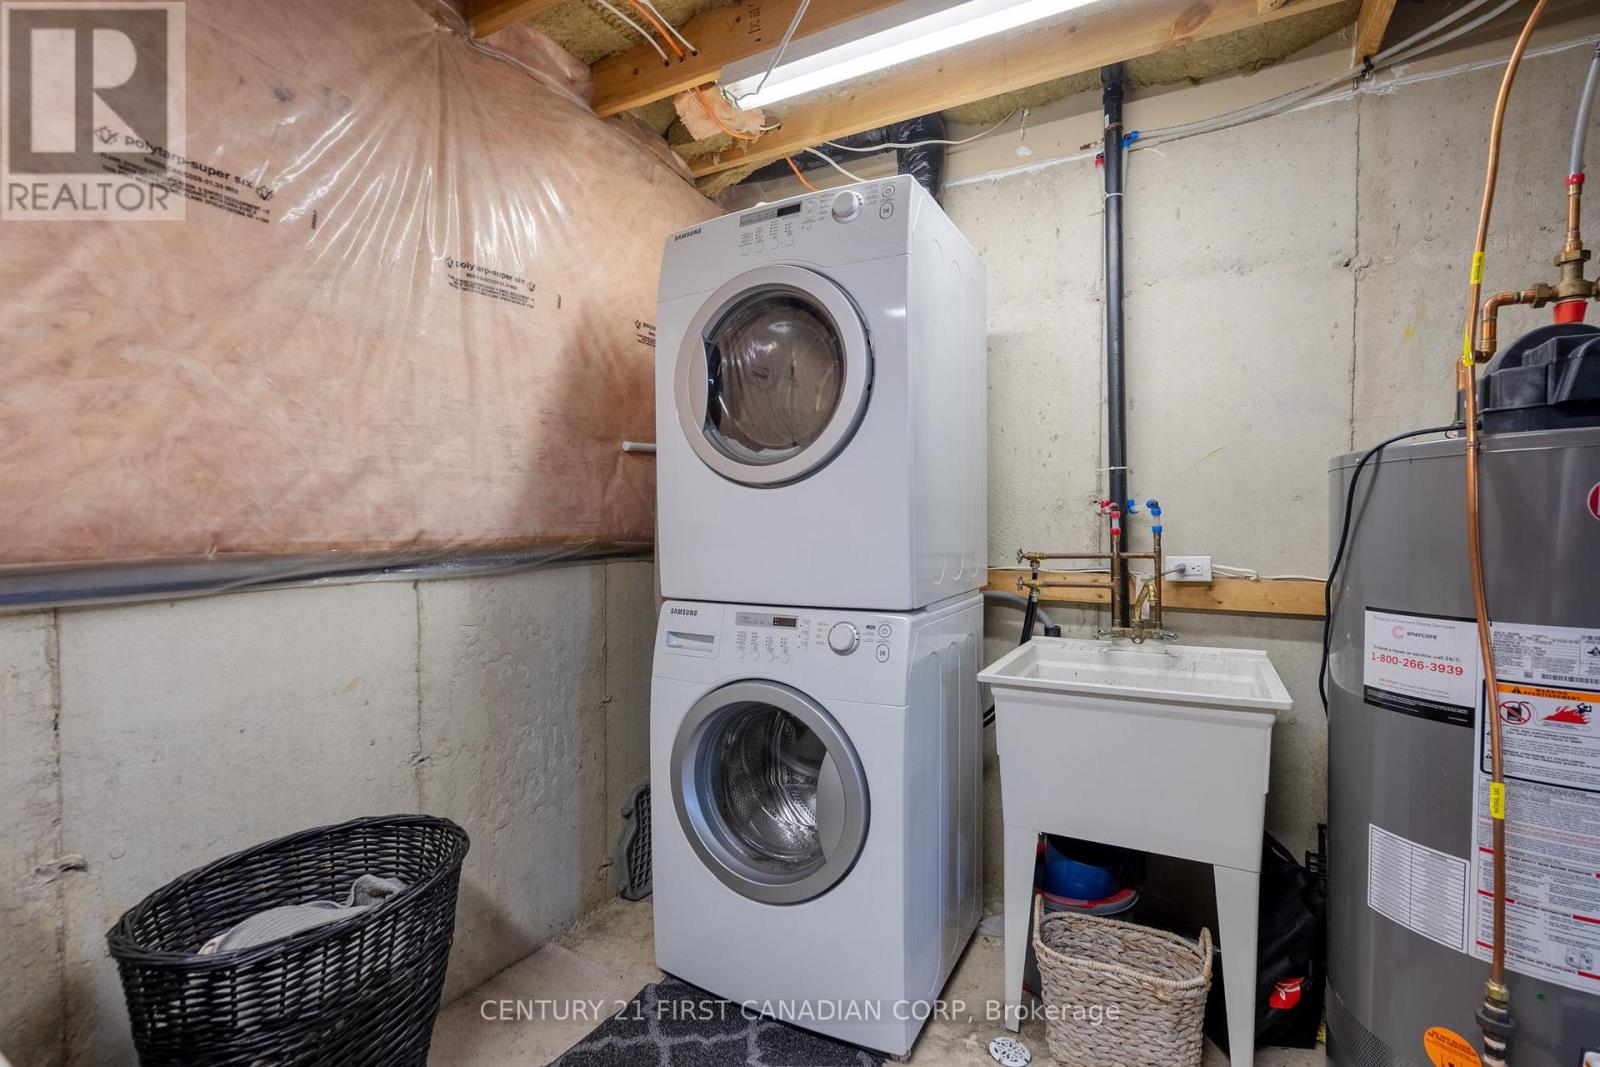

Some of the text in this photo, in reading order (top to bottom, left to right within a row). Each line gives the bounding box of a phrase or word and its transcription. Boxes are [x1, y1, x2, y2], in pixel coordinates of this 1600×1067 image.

[234, 175, 253, 190] six
[674, 227, 702, 241] SAMSUNG
[670, 608, 698, 617] SAMSUNG
[1407, 631, 1438, 640] enercare
[1371, 652, 1464, 676] 1-800-266-3939
